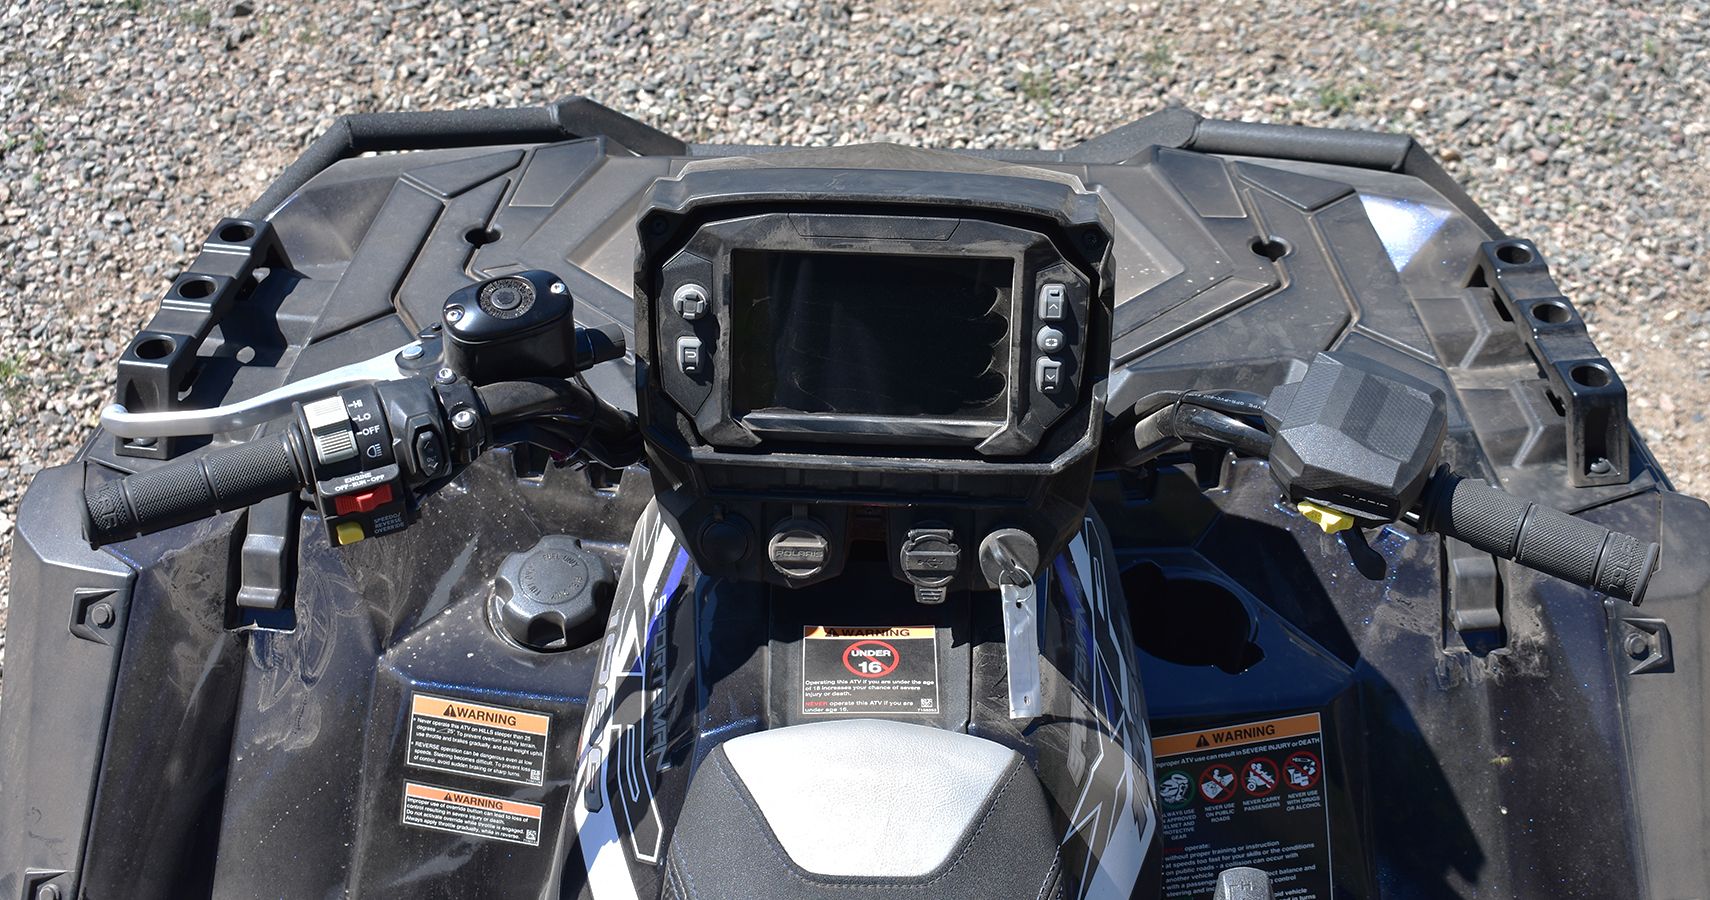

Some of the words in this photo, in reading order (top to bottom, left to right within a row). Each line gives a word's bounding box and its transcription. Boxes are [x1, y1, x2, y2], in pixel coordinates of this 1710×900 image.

[353, 399, 363, 408] HI
[359, 413, 371, 422] LO
[362, 424, 381, 436] OFF
[344, 472, 372, 484] ENGINE
[841, 628, 910, 637] WARNING
[858, 661, 881, 673] 16
[652, 593, 671, 774] SPORTSMAN
[456, 707, 516, 726] WARNING
[431, 720, 450, 728] operate
[494, 730, 512, 738] steeper
[1212, 724, 1275, 743] WARNING
[414, 741, 439, 750] REVERSE
[440, 745, 462, 755] operation
[479, 751, 504, 762] dangerous
[1217, 750, 1236, 758] result
[1241, 745, 1267, 754] SEVERE
[1267, 742, 1290, 750] INJURY
[1298, 737, 1319, 745] DEATH
[407, 797, 429, 805] Improper
[453, 794, 503, 810] WARNING
[424, 806, 445, 815] resulting
[443, 815, 463, 823] override
